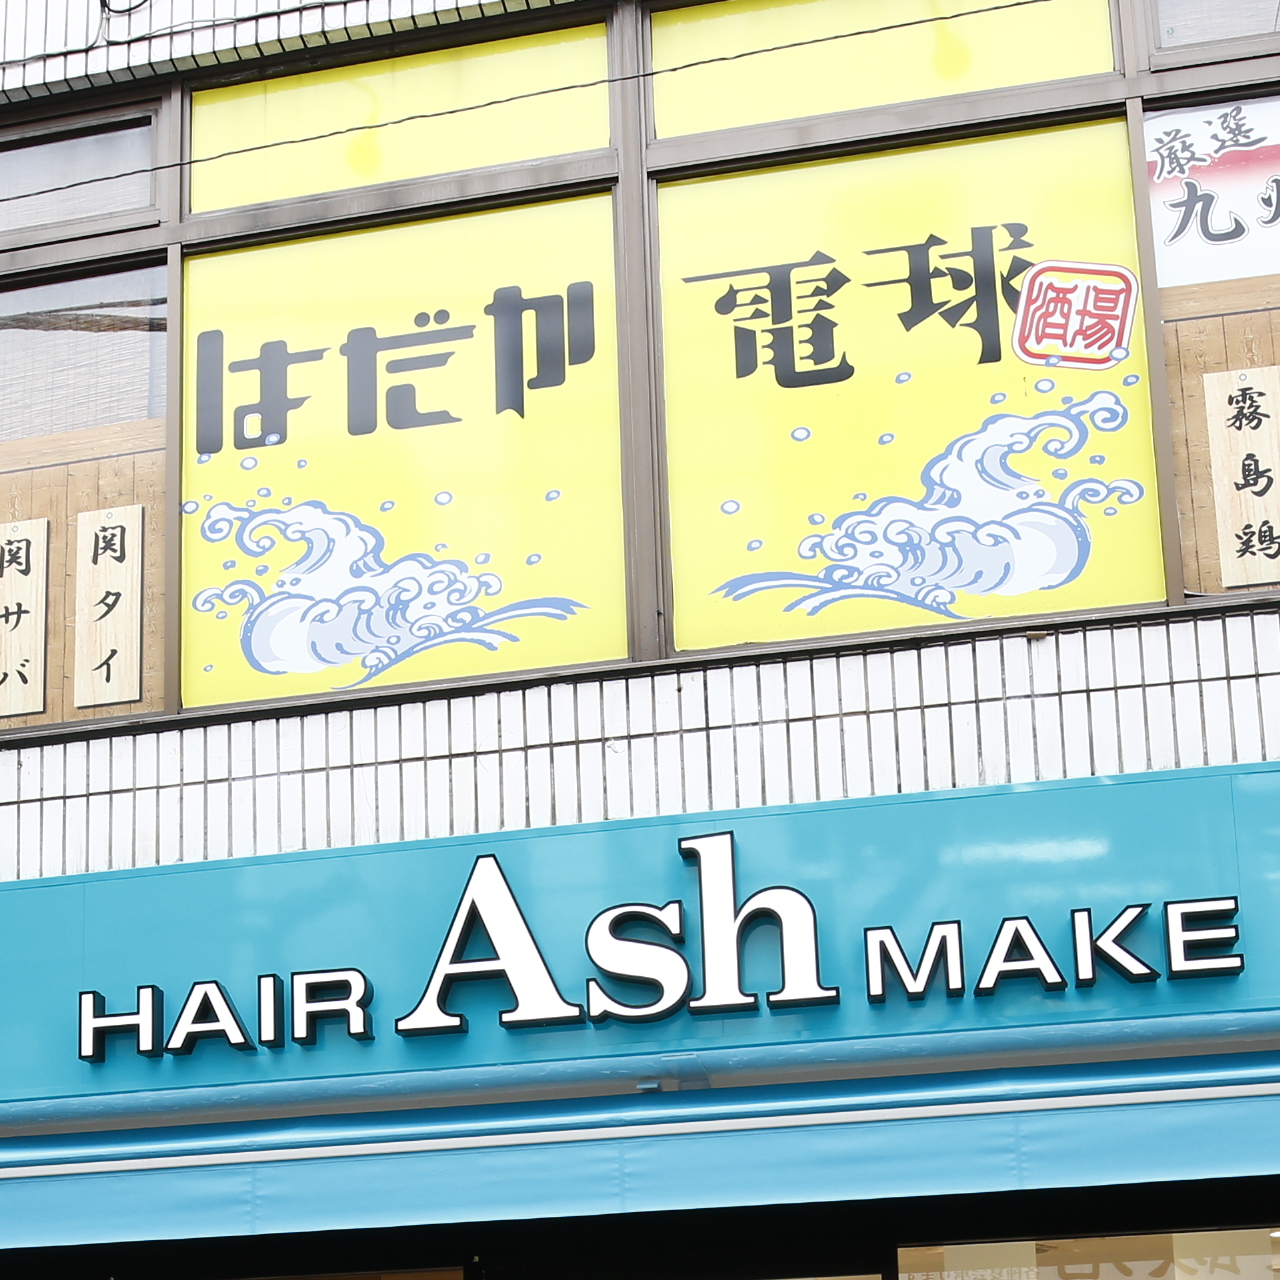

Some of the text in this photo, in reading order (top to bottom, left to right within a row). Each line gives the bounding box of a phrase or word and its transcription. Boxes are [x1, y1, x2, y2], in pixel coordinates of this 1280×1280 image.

[1152, 105, 1268, 180] 厳選
[195, 222, 1034, 454] はだか 電球
[1019, 276, 1129, 354] 酒場
[91, 525, 128, 685] 関タイ
[78, 830, 1245, 1063] HAIR Ash MAKE
